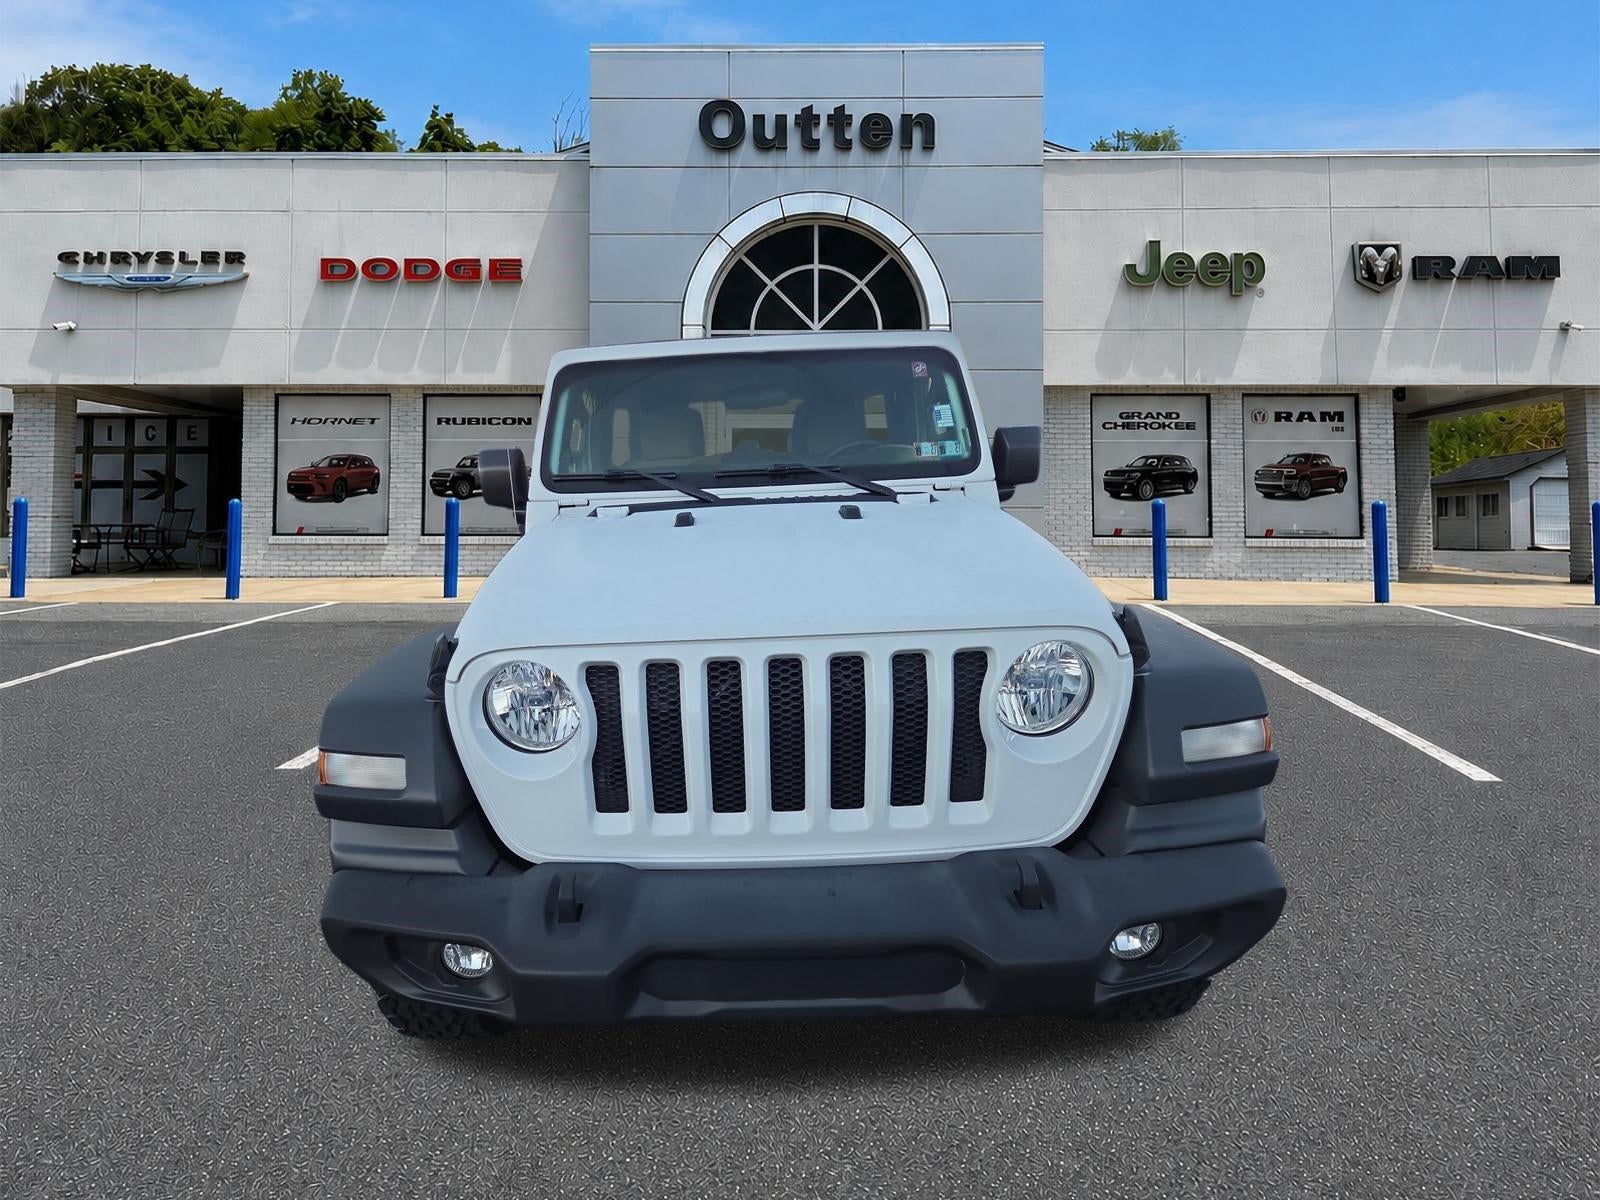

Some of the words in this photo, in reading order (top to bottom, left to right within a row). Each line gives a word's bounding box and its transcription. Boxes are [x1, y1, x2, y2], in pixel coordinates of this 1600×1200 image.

[698, 99, 936, 150] Outten
[57, 251, 247, 265] CHRYSLER
[320, 257, 523, 283] DODGE
[1123, 240, 1266, 296] Jeep
[1411, 255, 1561, 280] RAM
[290, 417, 381, 426] HORNET
[436, 417, 533, 426] RUBICON
[1118, 411, 1180, 420] GRAND
[1274, 411, 1344, 423] RAM
[1101, 421, 1197, 431] CHEROKEE
